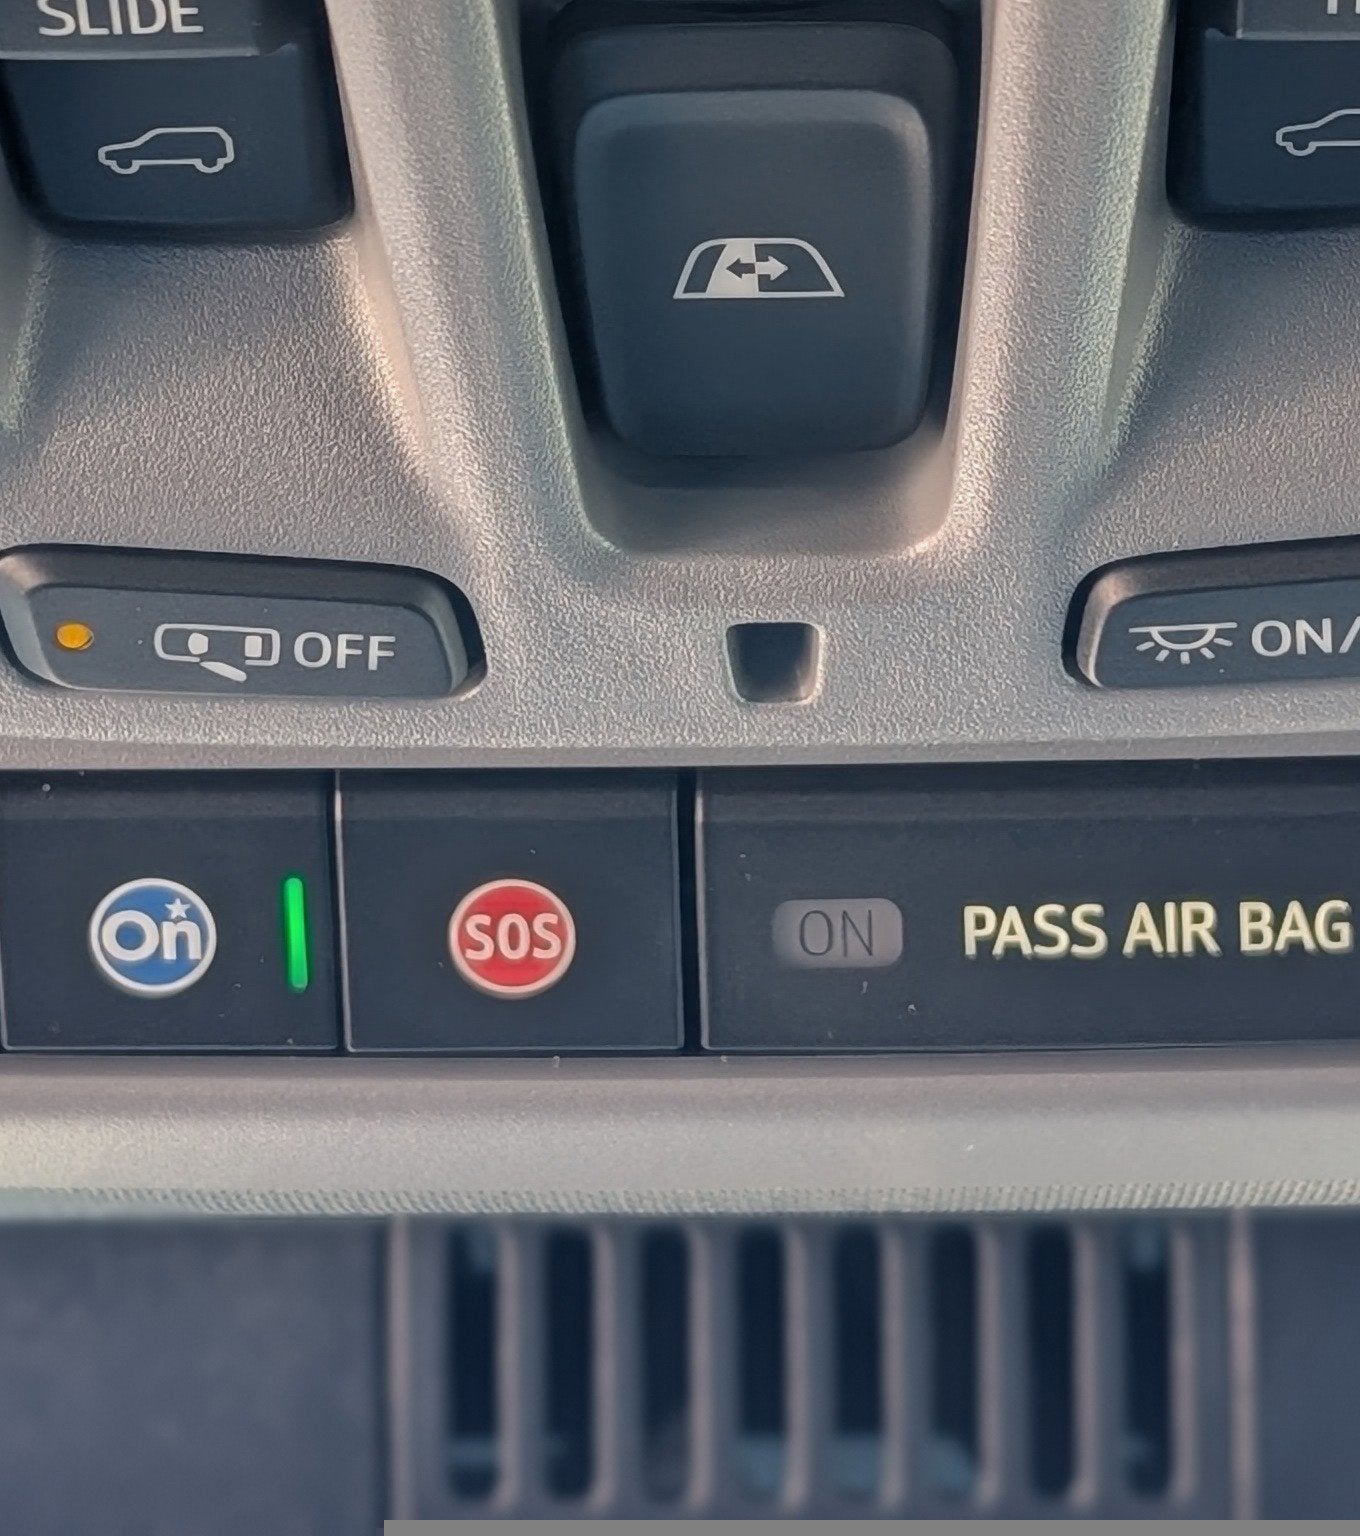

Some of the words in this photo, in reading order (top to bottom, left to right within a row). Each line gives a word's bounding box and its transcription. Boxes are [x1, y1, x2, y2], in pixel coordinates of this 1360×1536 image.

[293, 632, 396, 671] OFF
[100, 907, 203, 962] On
[464, 912, 563, 960] SOS
[798, 908, 875, 958] ON
[964, 904, 1107, 957] PASS
[1122, 902, 1222, 955] AIR
[1239, 900, 1354, 954] BAG
